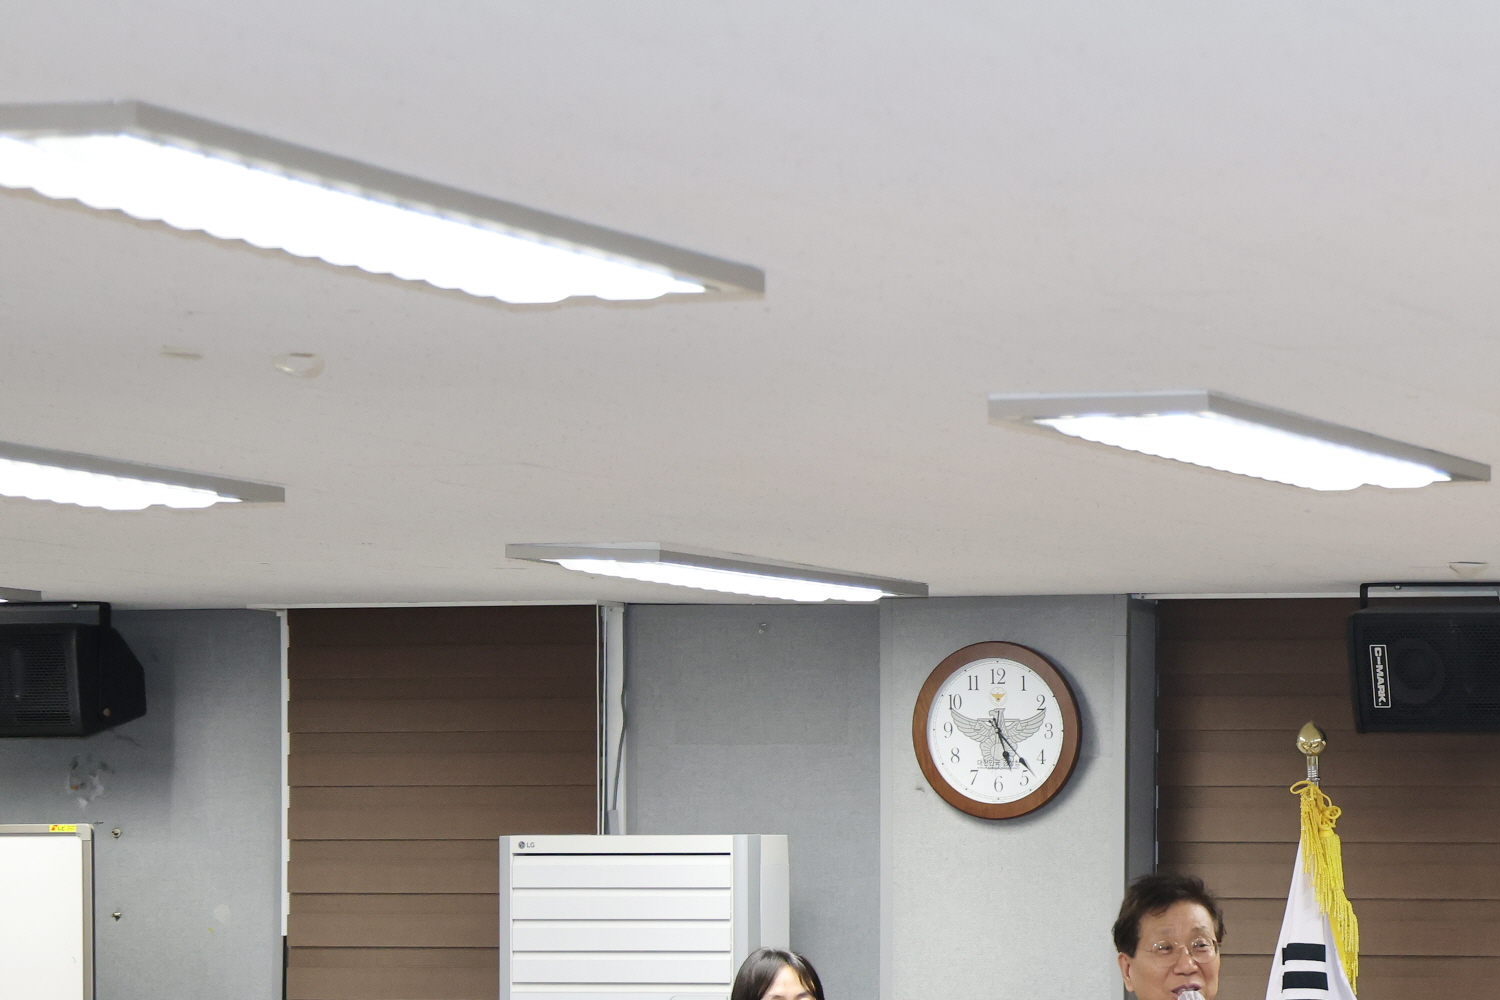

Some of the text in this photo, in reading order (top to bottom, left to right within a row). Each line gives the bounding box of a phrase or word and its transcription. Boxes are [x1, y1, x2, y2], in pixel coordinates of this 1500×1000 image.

[968, 675, 980, 691] 11
[990, 668, 1006, 685] 12
[948, 694, 962, 710] 10
[1036, 695, 1046, 711] 2
[943, 722, 953, 739] 9
[1044, 723, 1054, 739] 3
[951, 747, 960, 764] 8
[1037, 749, 1046, 764] 4
[970, 769, 978, 785] 7
[993, 776, 1004, 792] 6
[1019, 769, 1029, 786] 5
